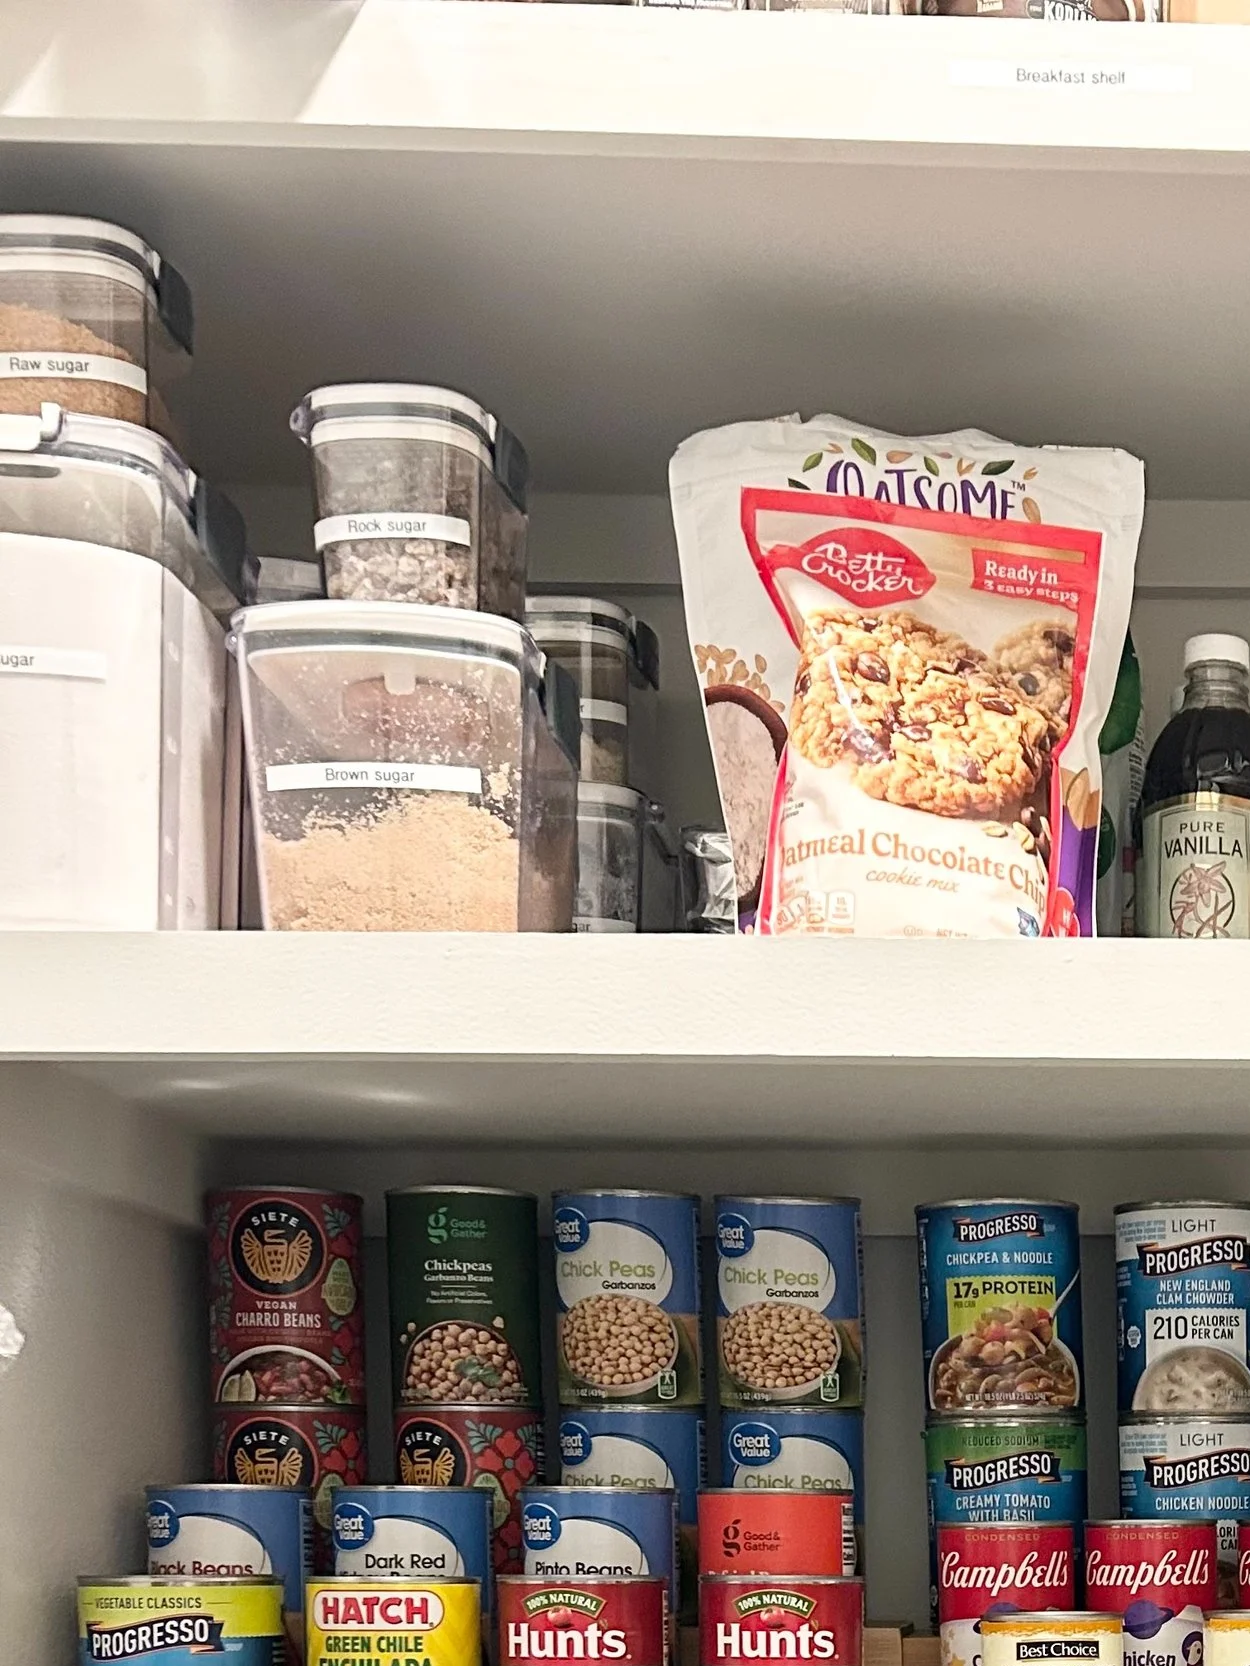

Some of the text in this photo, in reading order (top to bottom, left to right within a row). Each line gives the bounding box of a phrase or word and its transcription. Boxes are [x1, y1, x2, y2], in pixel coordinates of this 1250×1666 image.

[1016, 68, 1126, 84] Breakfast shelf
[9, 357, 90, 375] Raw sugar
[347, 518, 427, 535] Rock sugar
[815, 542, 905, 577] Betty
[802, 553, 926, 596] Crocker
[984, 560, 1038, 585] Ready
[998, 584, 1079, 603] easy steps
[325, 767, 415, 785] Brown sugar
[1178, 819, 1226, 834] PURE
[871, 832, 1006, 881] Chocolate
[1163, 838, 1244, 860] VANILLA
[866, 866, 961, 894] cookie mix
[251, 1211, 300, 1228] SIETE
[960, 1214, 1037, 1241] PROGRESSO
[1171, 1219, 1216, 1233] LIGHT
[946, 1251, 1053, 1266] CHICKPEA NOODLE
[1145, 1239, 1245, 1274] PROGRESSO
[424, 1260, 493, 1275] Chickpeas
[561, 1260, 656, 1278] Chick Peas
[602, 1280, 656, 1291] Garbanzos
[953, 1280, 1054, 1300] 17g PROTEIN
[1159, 1279, 1231, 1292] NEW ENGLAND
[256, 1301, 297, 1310] VEGAN
[1156, 1292, 1235, 1305] CLAM CHOWDER
[235, 1312, 321, 1329] CHARRO BEANS
[1153, 1315, 1188, 1341] 210
[1191, 1315, 1240, 1328] CALORIES
[1191, 1327, 1234, 1340] PER CAN
[961, 1435, 1040, 1446] REDUCED SODIUM
[955, 1494, 1051, 1511] CREAMY TOMATO
[365, 1553, 445, 1569] Dark Red
[940, 1550, 1069, 1596] Campbell's
[96, 1597, 202, 1609] VEGETABLE CLASSICS
[526, 1593, 598, 1611] 100% NATURAL
[321, 1597, 429, 1625] HATCH
[92, 1619, 209, 1657] PROGRESSO
[325, 1636, 423, 1653] GREEN CHILE
[1019, 1642, 1097, 1658] Best Choice
